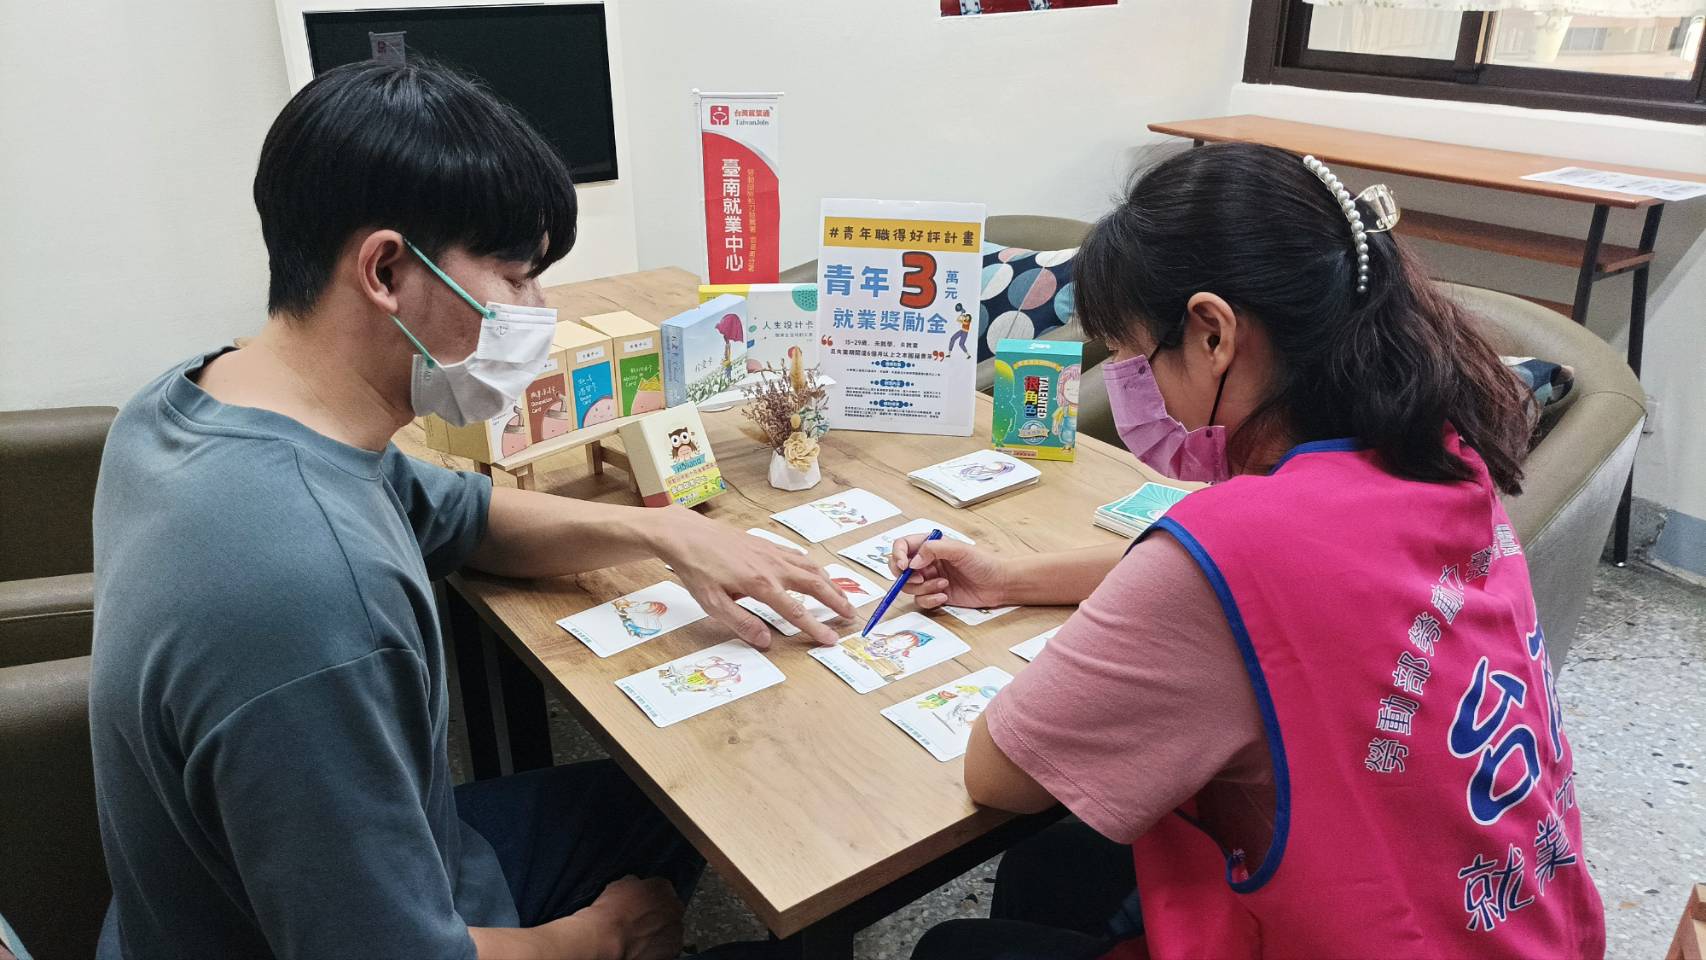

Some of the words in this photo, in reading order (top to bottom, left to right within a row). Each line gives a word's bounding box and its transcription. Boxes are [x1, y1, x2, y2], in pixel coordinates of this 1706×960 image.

[721, 159, 744, 272] 臺南就業中心
[829, 226, 975, 247] #青年職得好評計畫
[823, 263, 890, 298] 青年
[899, 251, 938, 310] 3
[944, 270, 960, 301] 萬元
[833, 307, 949, 335] 就業獎勵金
[1037, 376, 1049, 419] TALENTED
